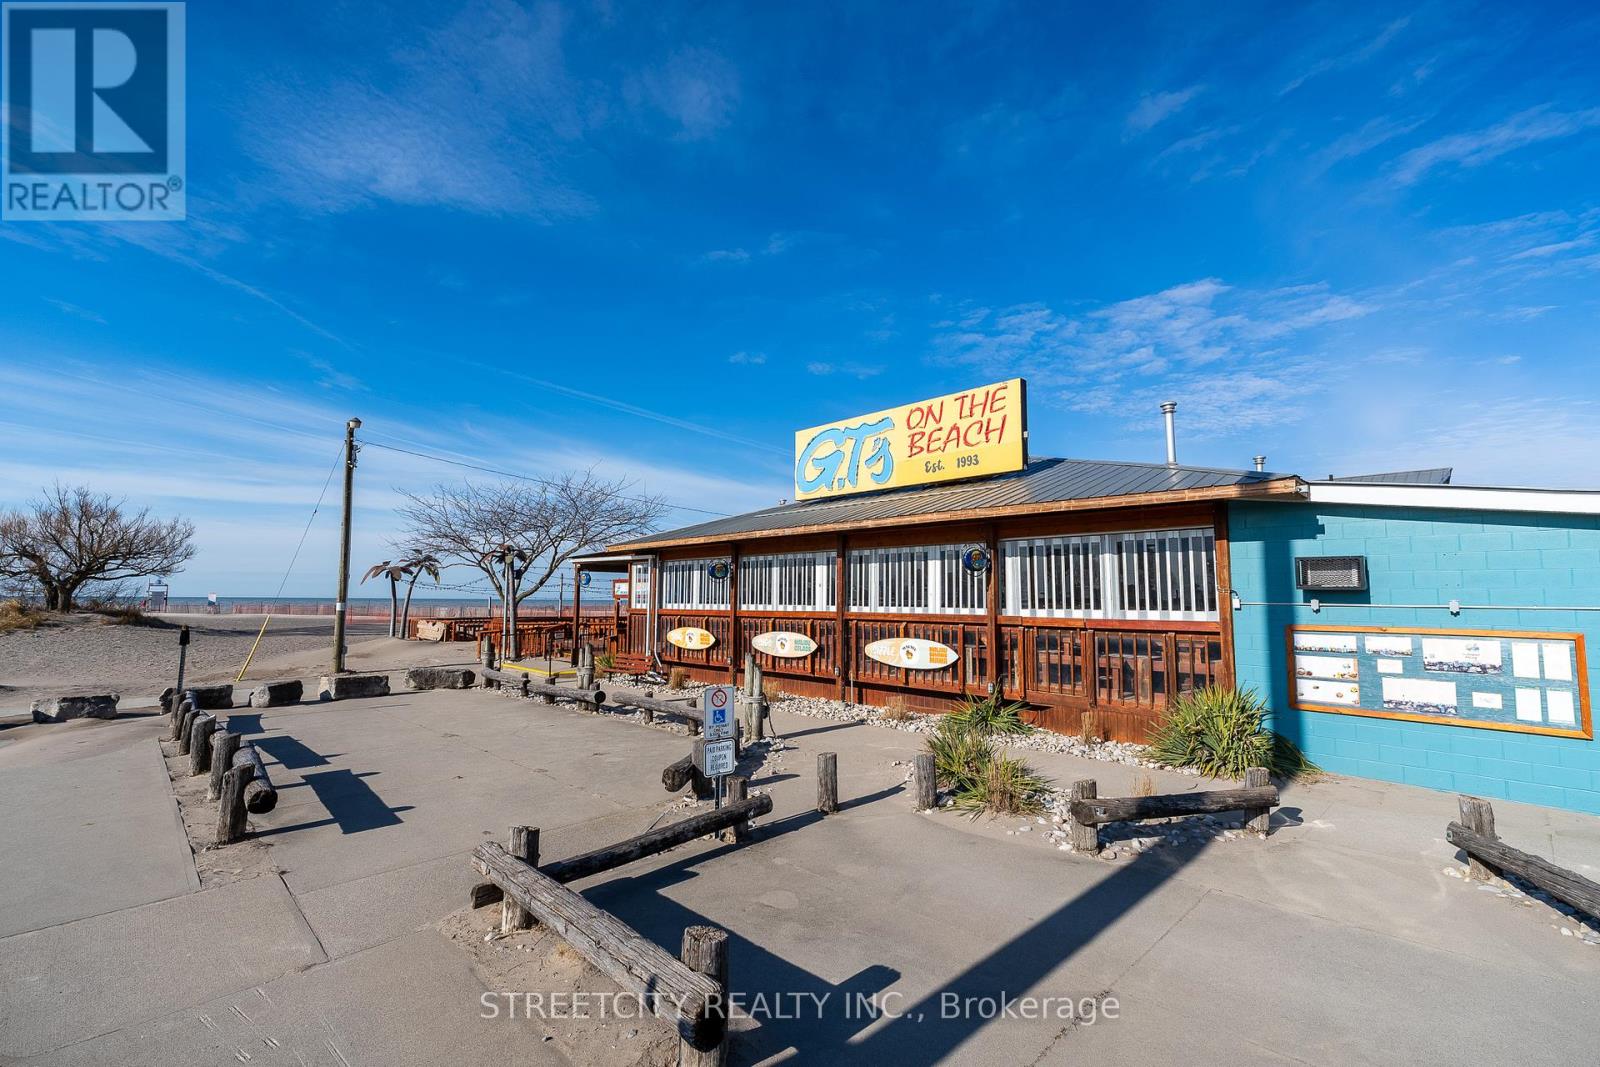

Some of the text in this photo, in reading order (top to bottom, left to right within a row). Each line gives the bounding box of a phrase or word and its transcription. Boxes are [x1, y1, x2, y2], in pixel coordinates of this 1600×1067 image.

[906, 383, 1008, 430] ON THE
[907, 414, 1007, 459] BEACH
[924, 454, 979, 473] Est. 1993
[716, 743, 732, 752] PARKING
[711, 753, 727, 762] COUPON
